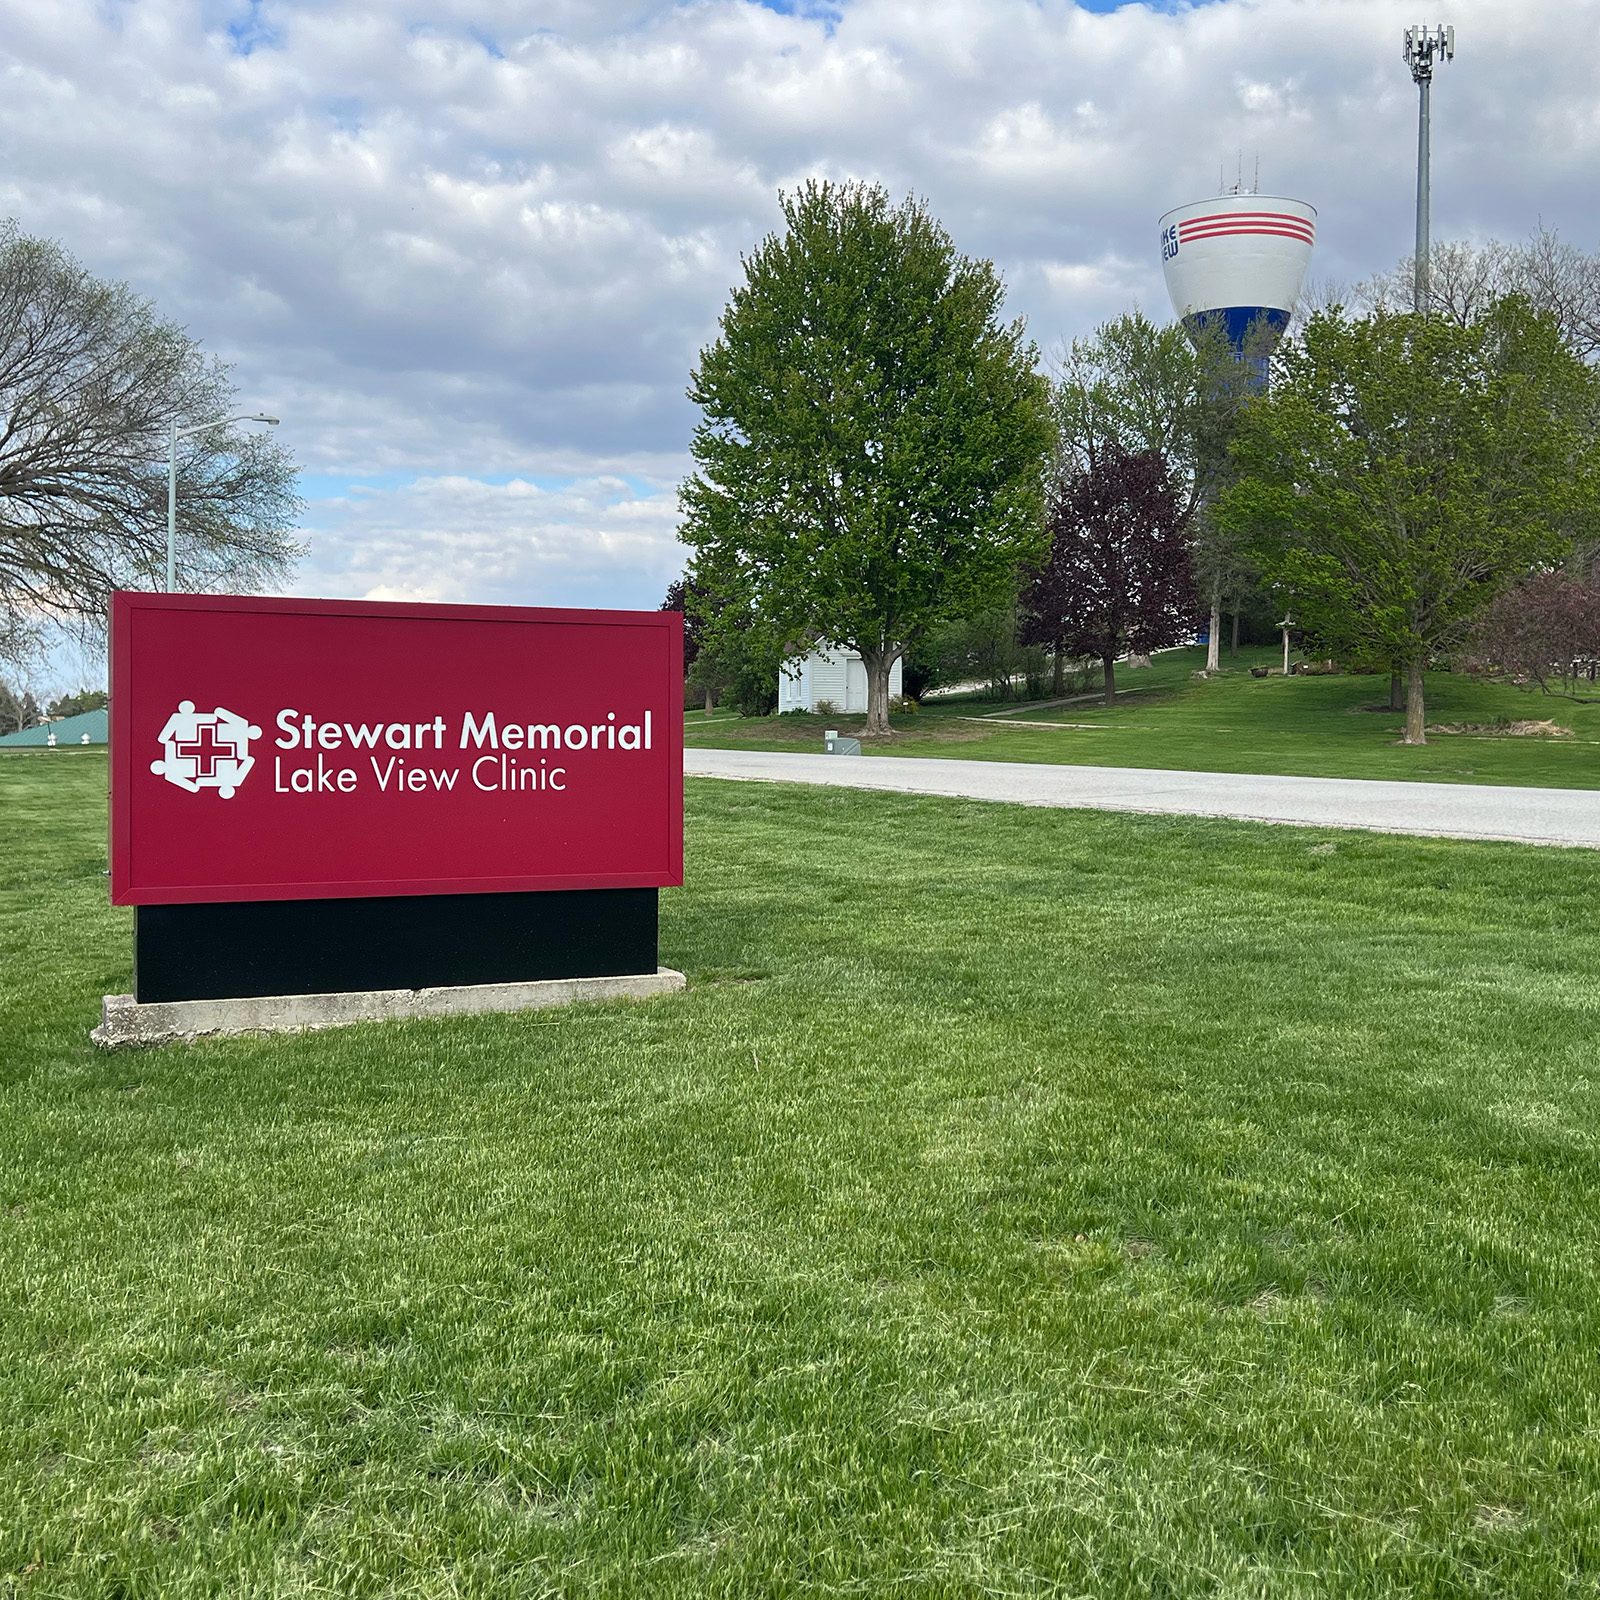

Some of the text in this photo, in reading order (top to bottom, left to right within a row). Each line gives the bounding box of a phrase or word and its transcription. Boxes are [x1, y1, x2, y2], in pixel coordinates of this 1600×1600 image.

[1161, 225, 1176, 246] KE
[1163, 240, 1178, 261] EW
[275, 708, 652, 750] Stewart Memorial
[275, 753, 567, 793] Lake View Clinic
